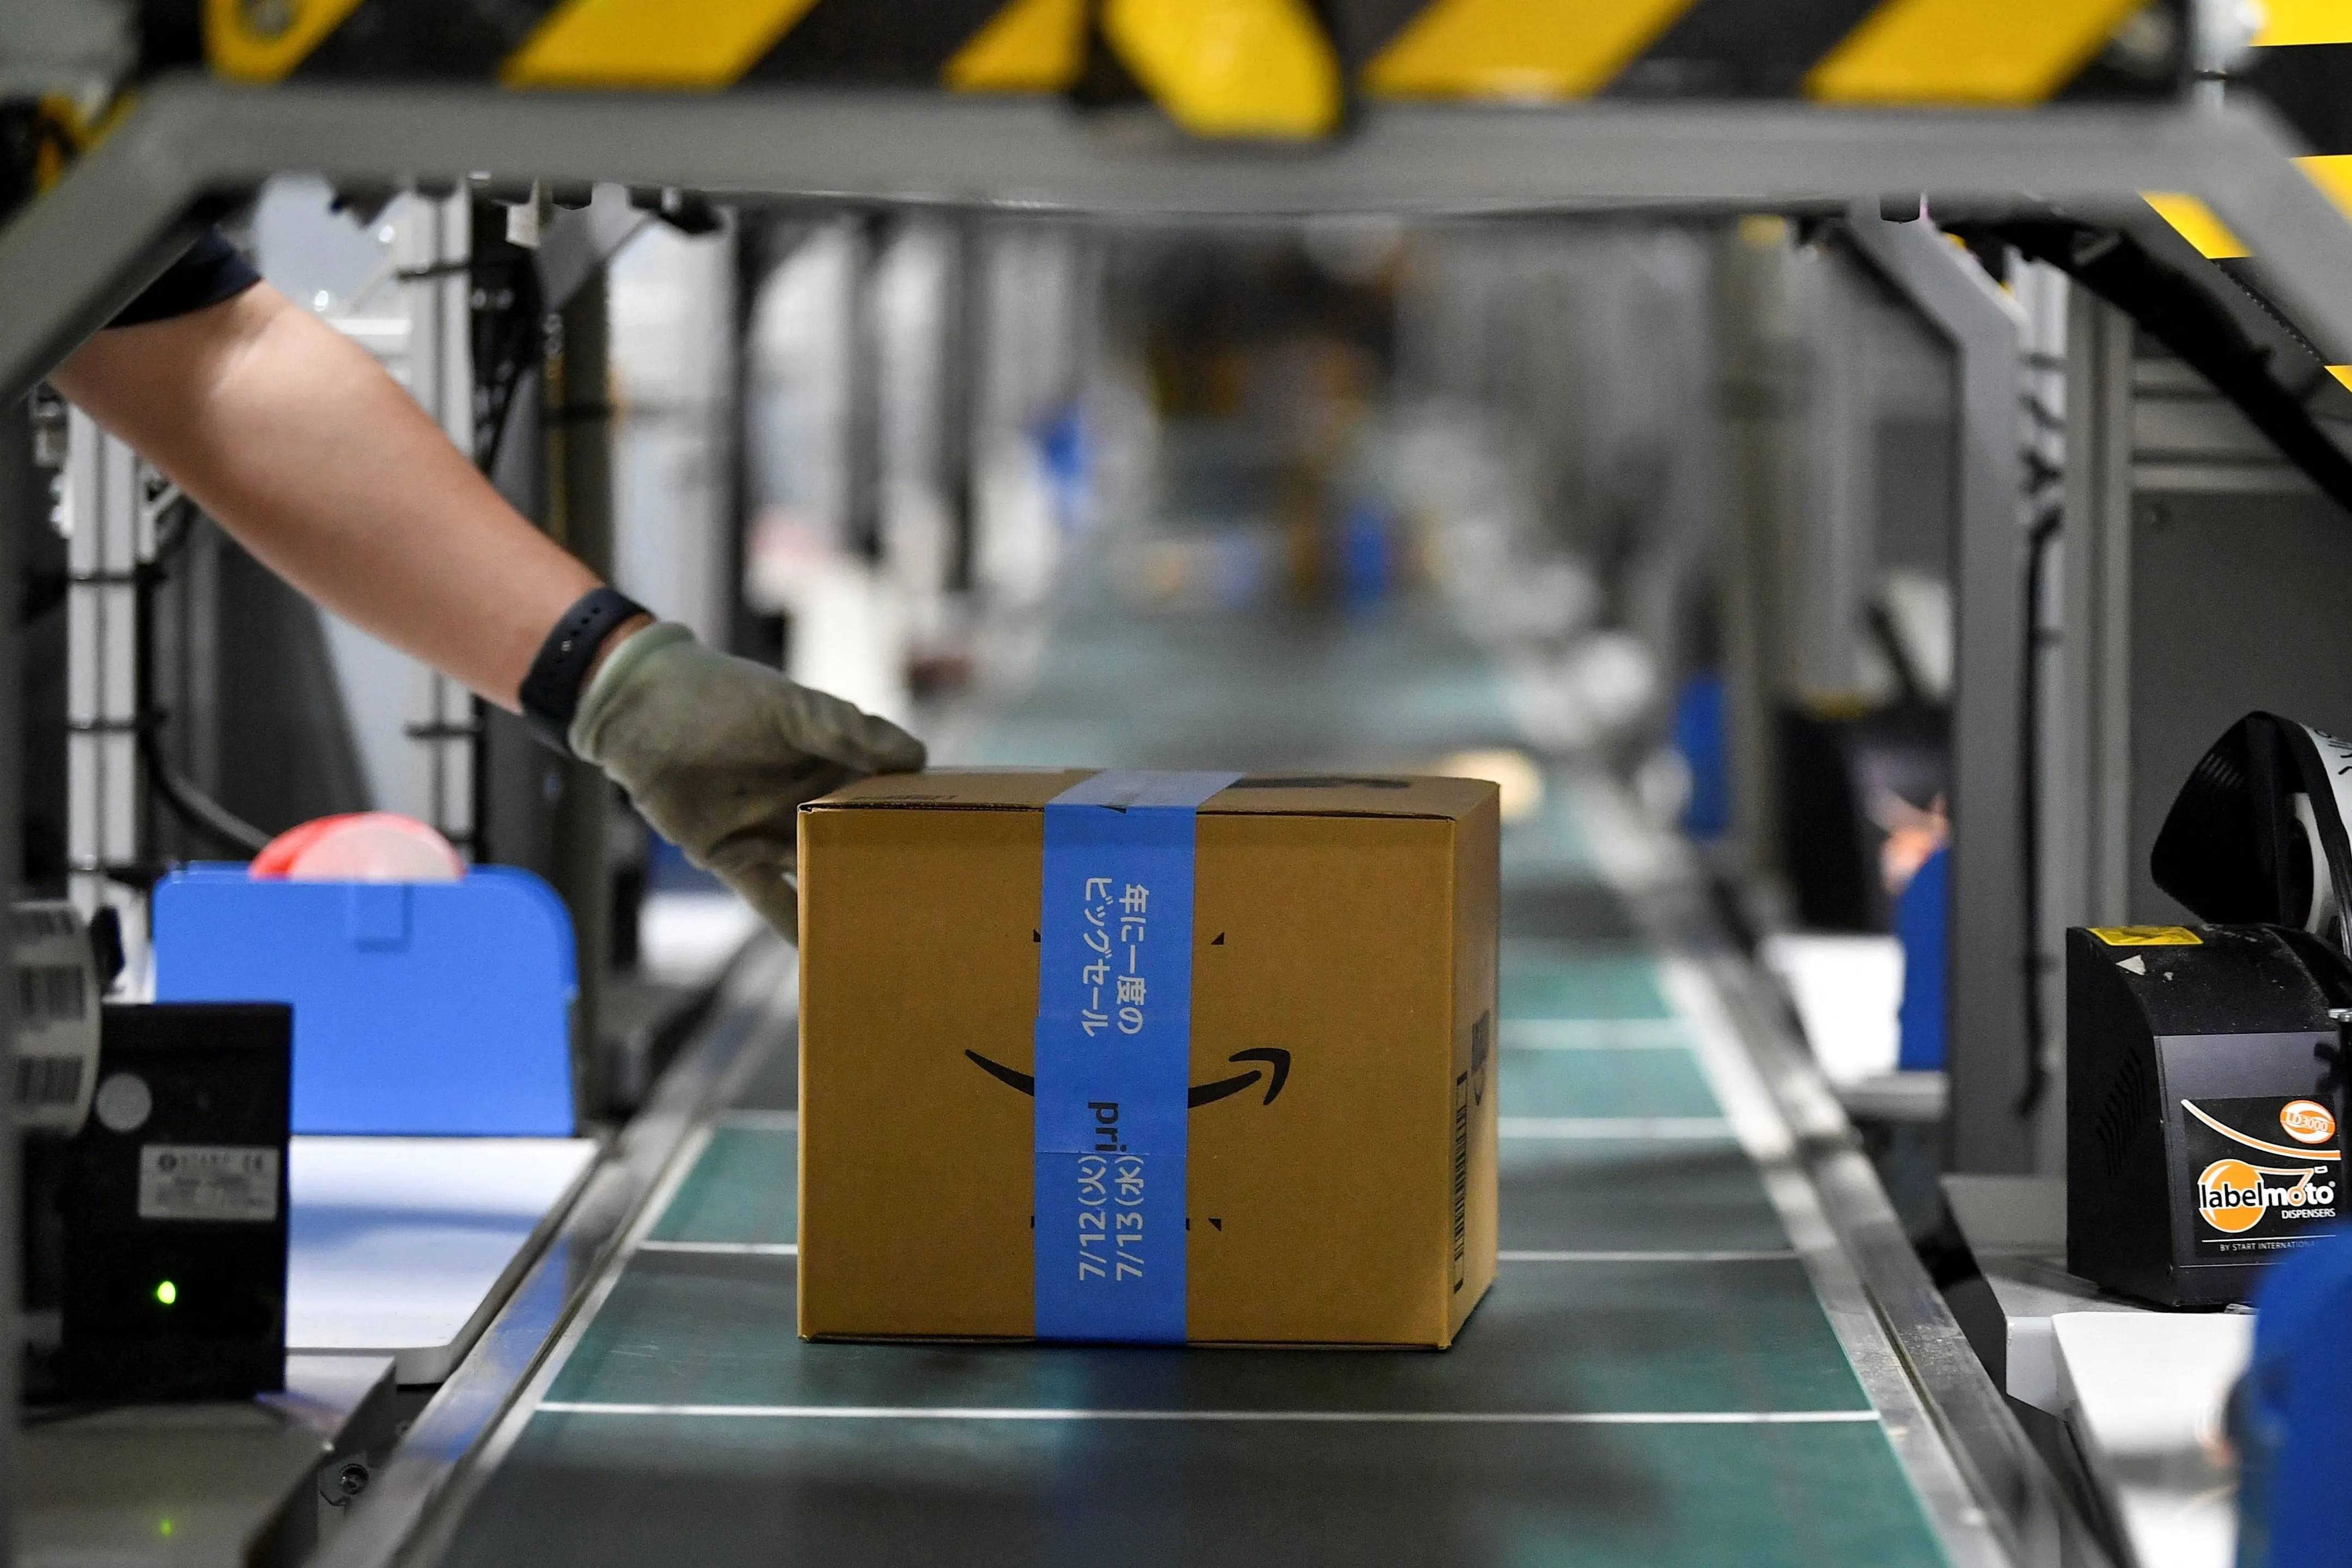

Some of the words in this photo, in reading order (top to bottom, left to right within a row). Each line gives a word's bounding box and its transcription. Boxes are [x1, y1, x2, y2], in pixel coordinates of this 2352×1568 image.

[1082, 877, 1113, 1037] ビッグセール
[1117, 883, 1149, 1034] 年に一度の
[2286, 1112, 2329, 1132] LD3000
[2281, 1208, 2336, 1219] DISPENSERS
[2232, 1243, 2256, 1251] START
